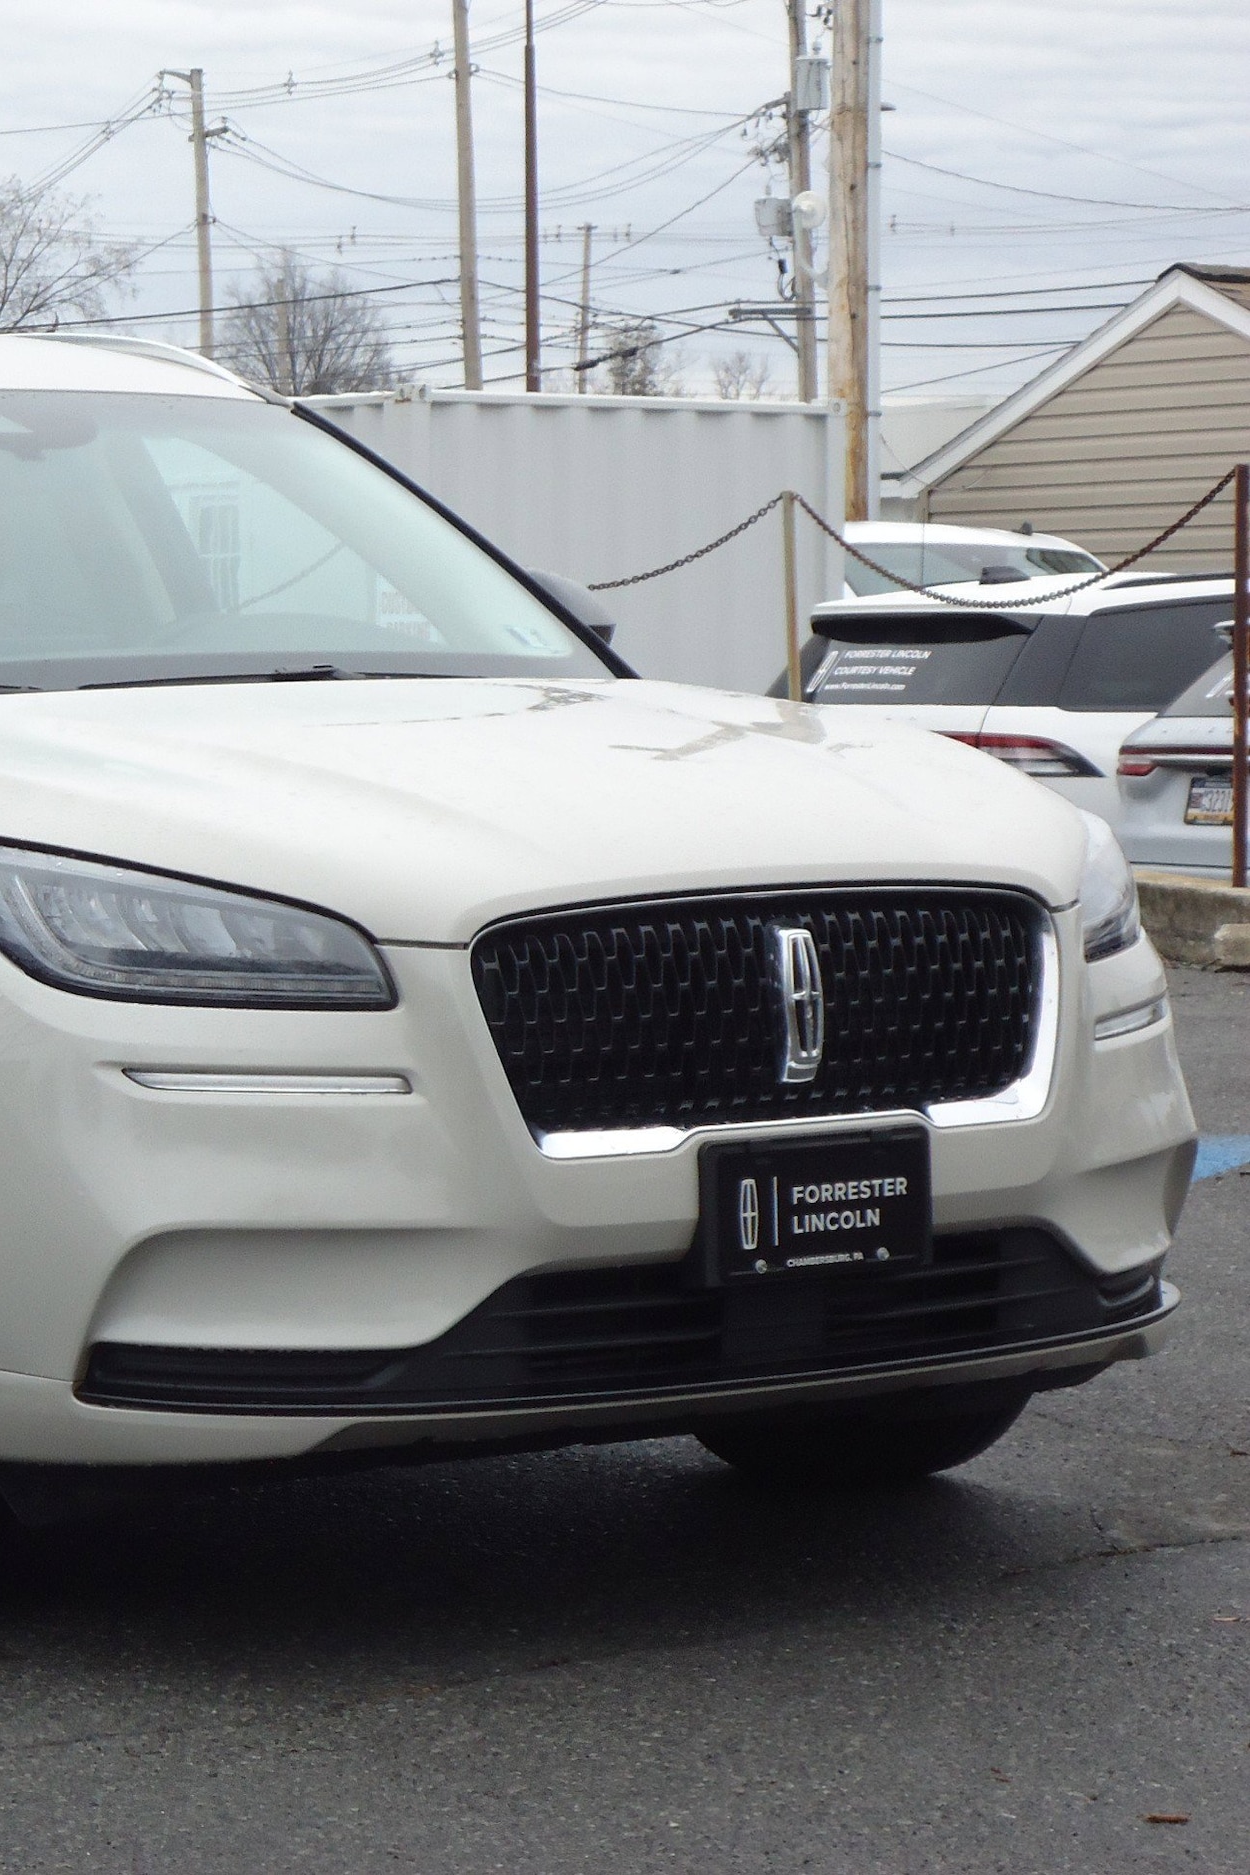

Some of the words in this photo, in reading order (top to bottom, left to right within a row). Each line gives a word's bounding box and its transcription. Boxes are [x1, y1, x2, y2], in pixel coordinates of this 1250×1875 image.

[844, 650, 892, 659] FORRESTER
[892, 650, 932, 659] LINCOLN
[834, 665, 878, 675] COURTESY
[879, 666, 917, 675] VEHICLE
[792, 1177, 908, 1205] FORRESTER
[792, 1208, 881, 1235] LINCOLN
[853, 1252, 864, 1261] PA
